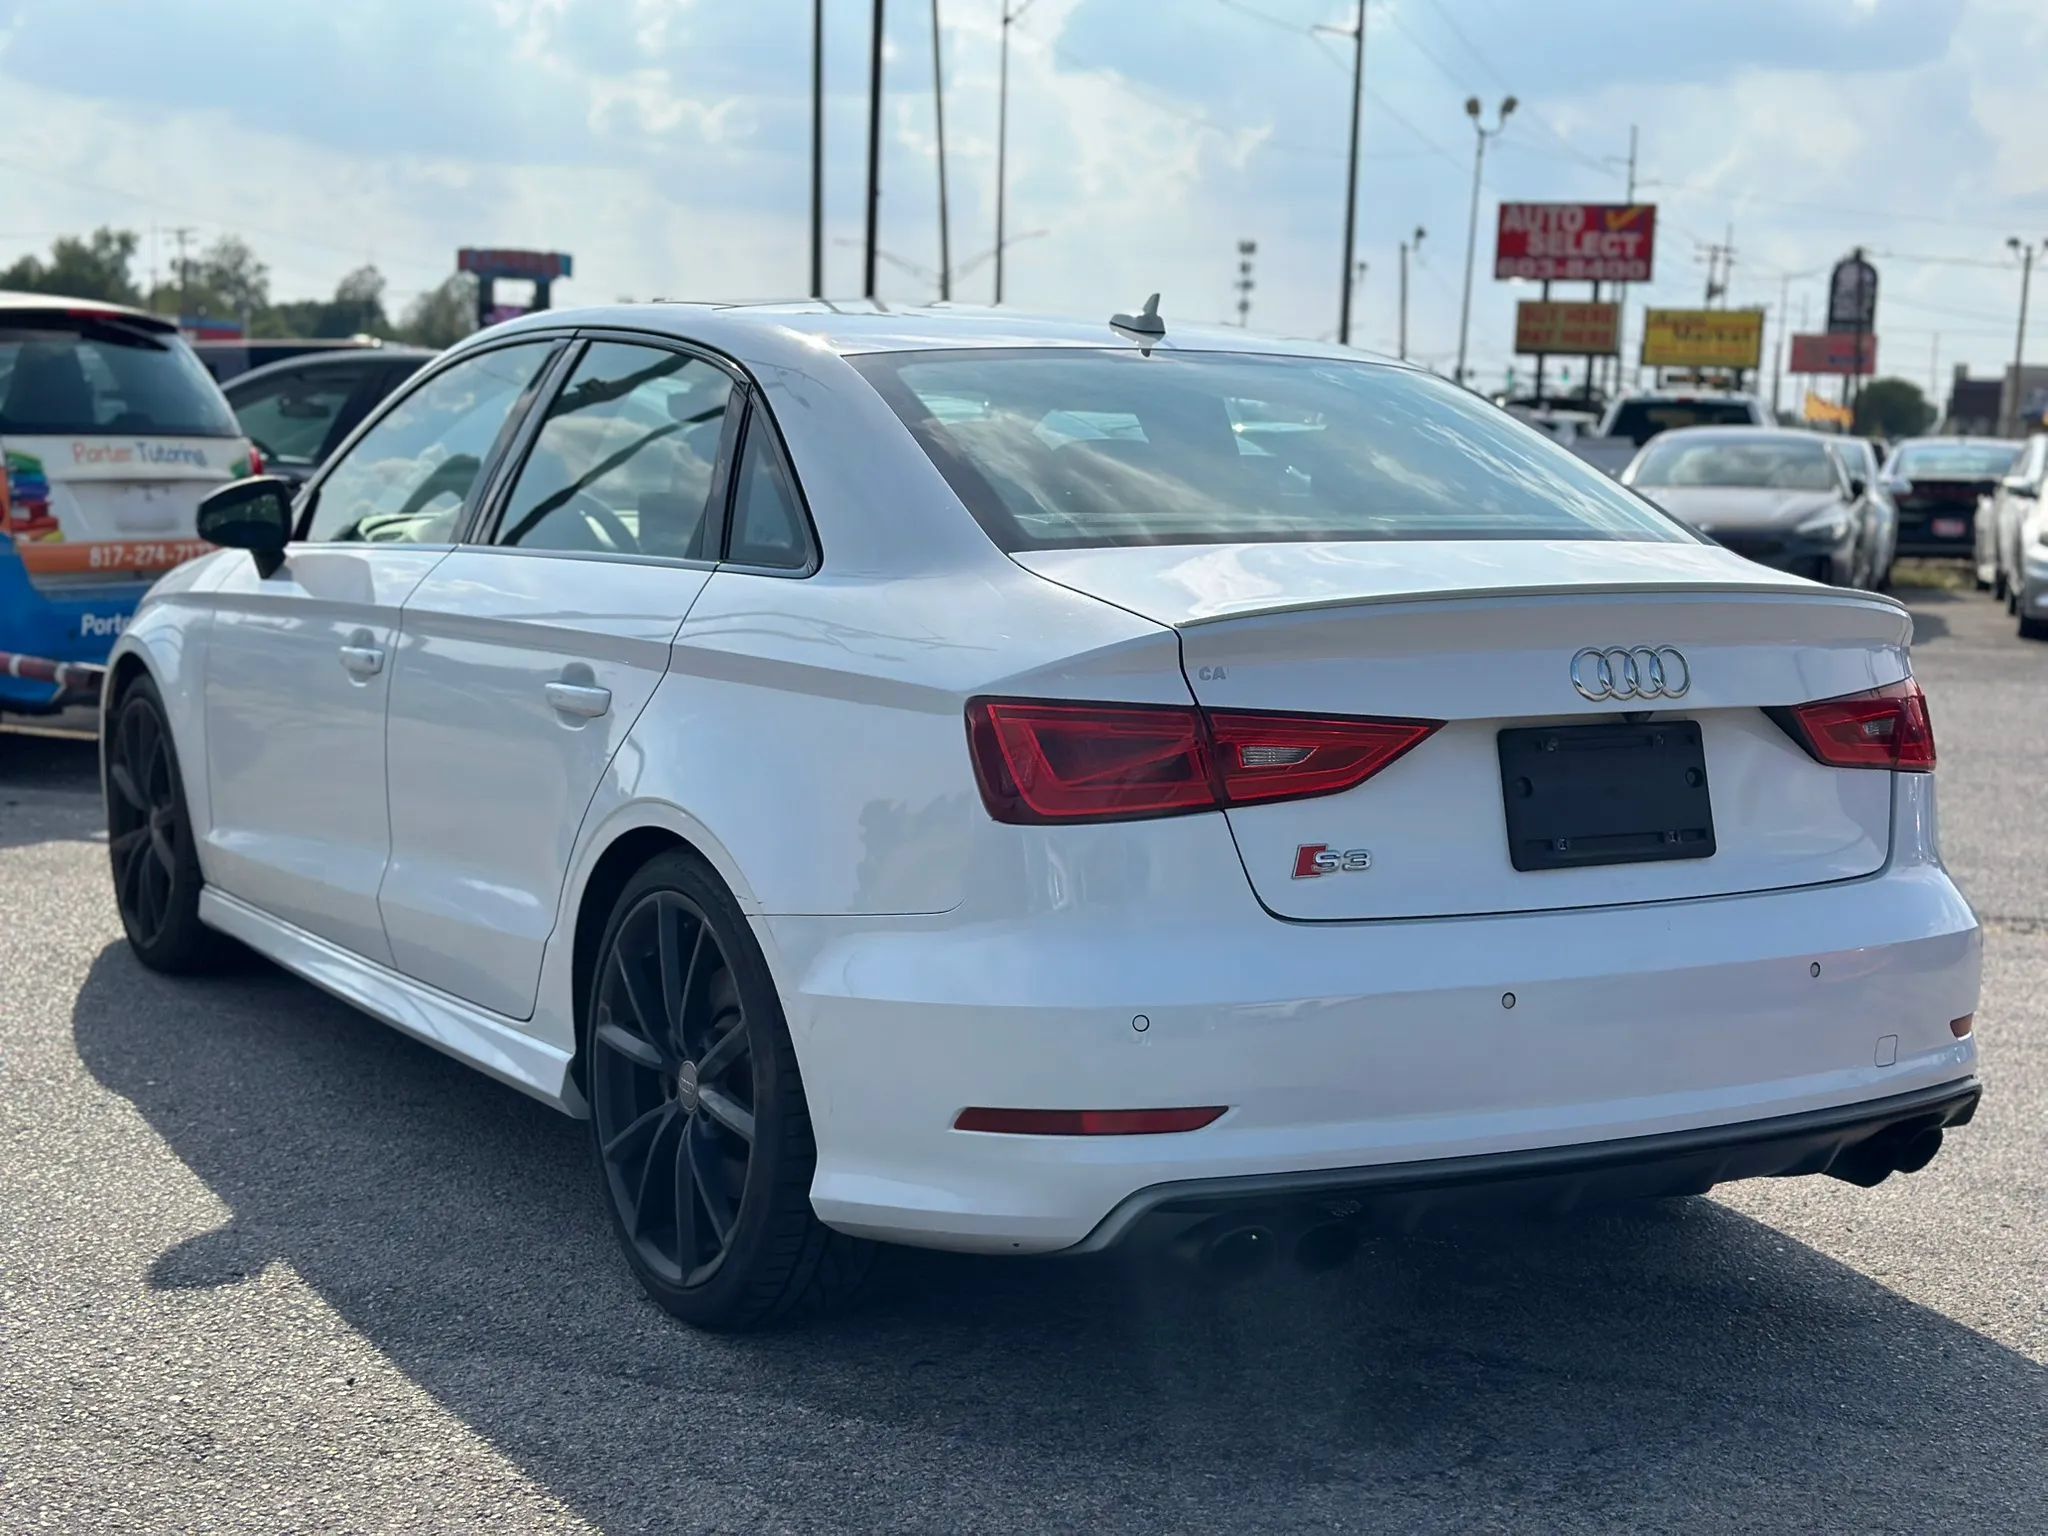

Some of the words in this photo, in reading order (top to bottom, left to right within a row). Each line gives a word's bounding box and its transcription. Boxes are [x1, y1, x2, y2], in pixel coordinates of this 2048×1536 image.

[1502, 205, 1586, 233] AUTO
[1525, 230, 1644, 257] SELECT
[1199, 666, 1227, 680] CA
[1311, 847, 1372, 873] S3
